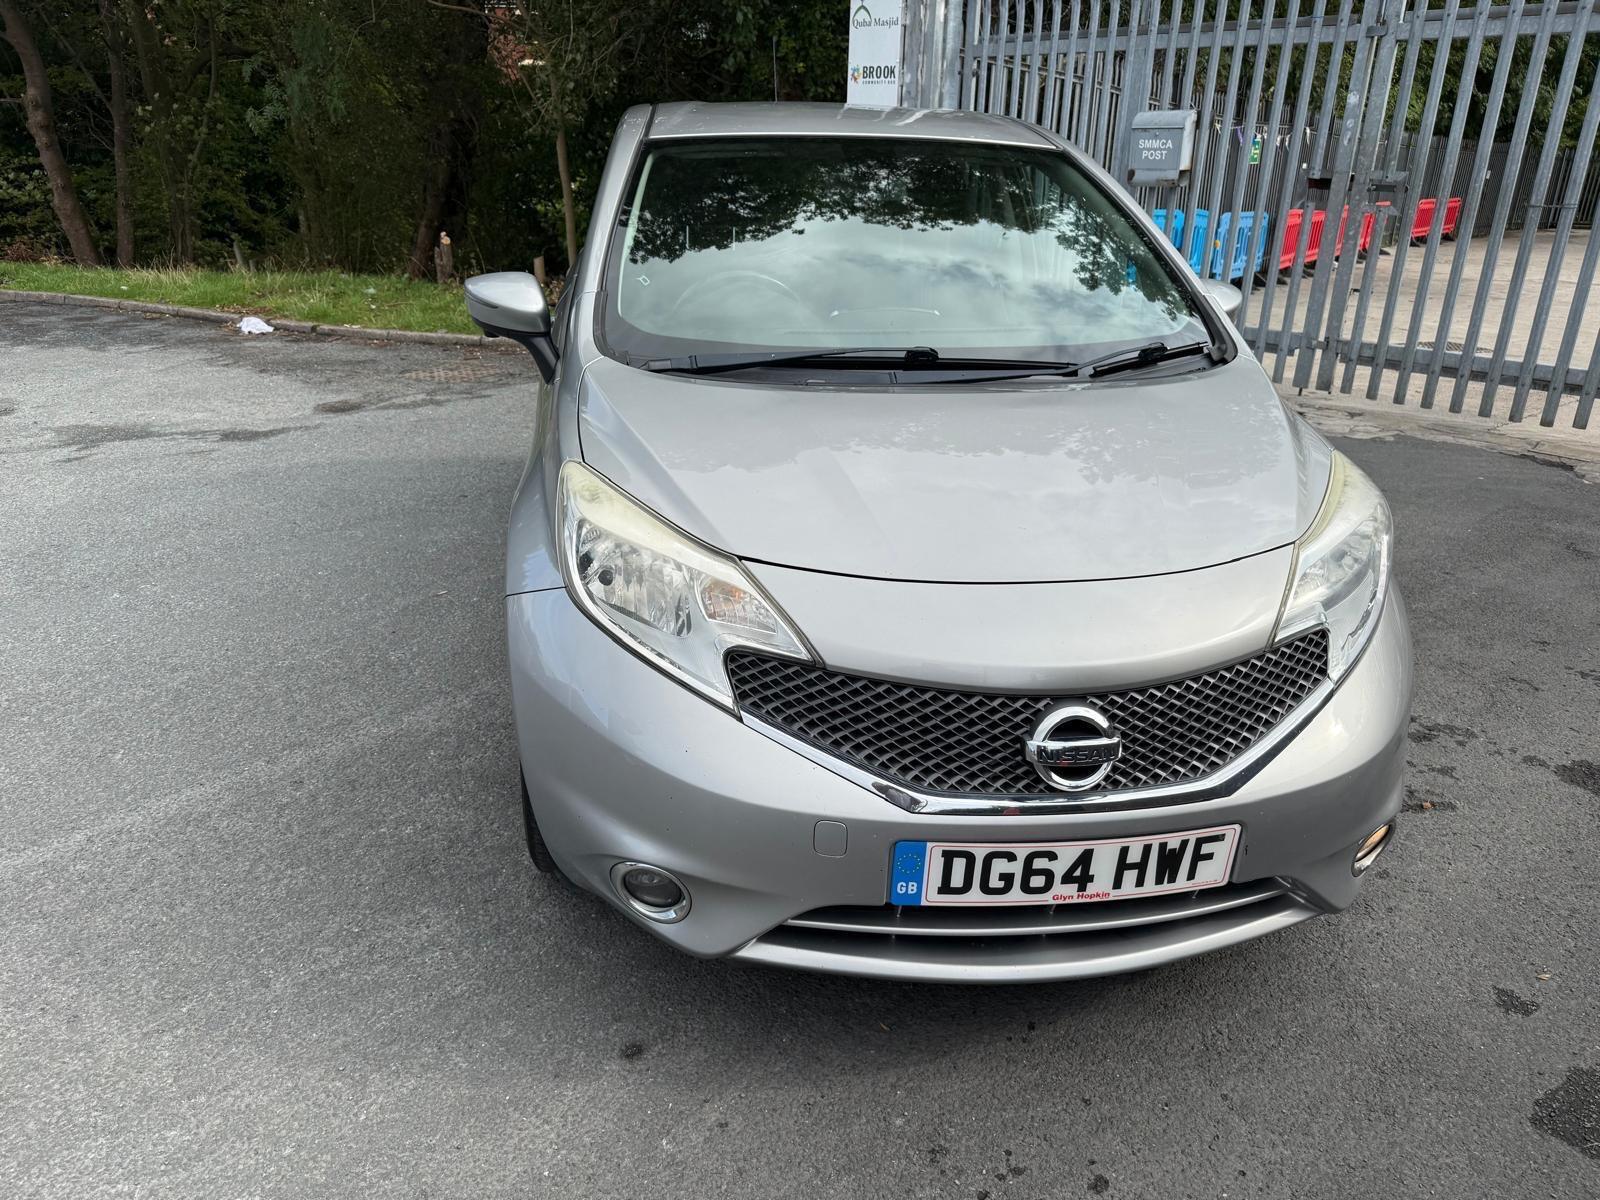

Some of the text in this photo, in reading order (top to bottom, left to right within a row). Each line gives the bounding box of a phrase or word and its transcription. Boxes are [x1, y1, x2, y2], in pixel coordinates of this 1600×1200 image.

[853, 17, 899, 29] Quba Masjid
[863, 65, 896, 79] BROOK
[1138, 139, 1173, 149] SMMCA
[1142, 151, 1168, 160] POST
[937, 833, 1226, 896] DG64 HWF
[897, 881, 917, 894] GB
[1076, 891, 1111, 901] Hopkin
